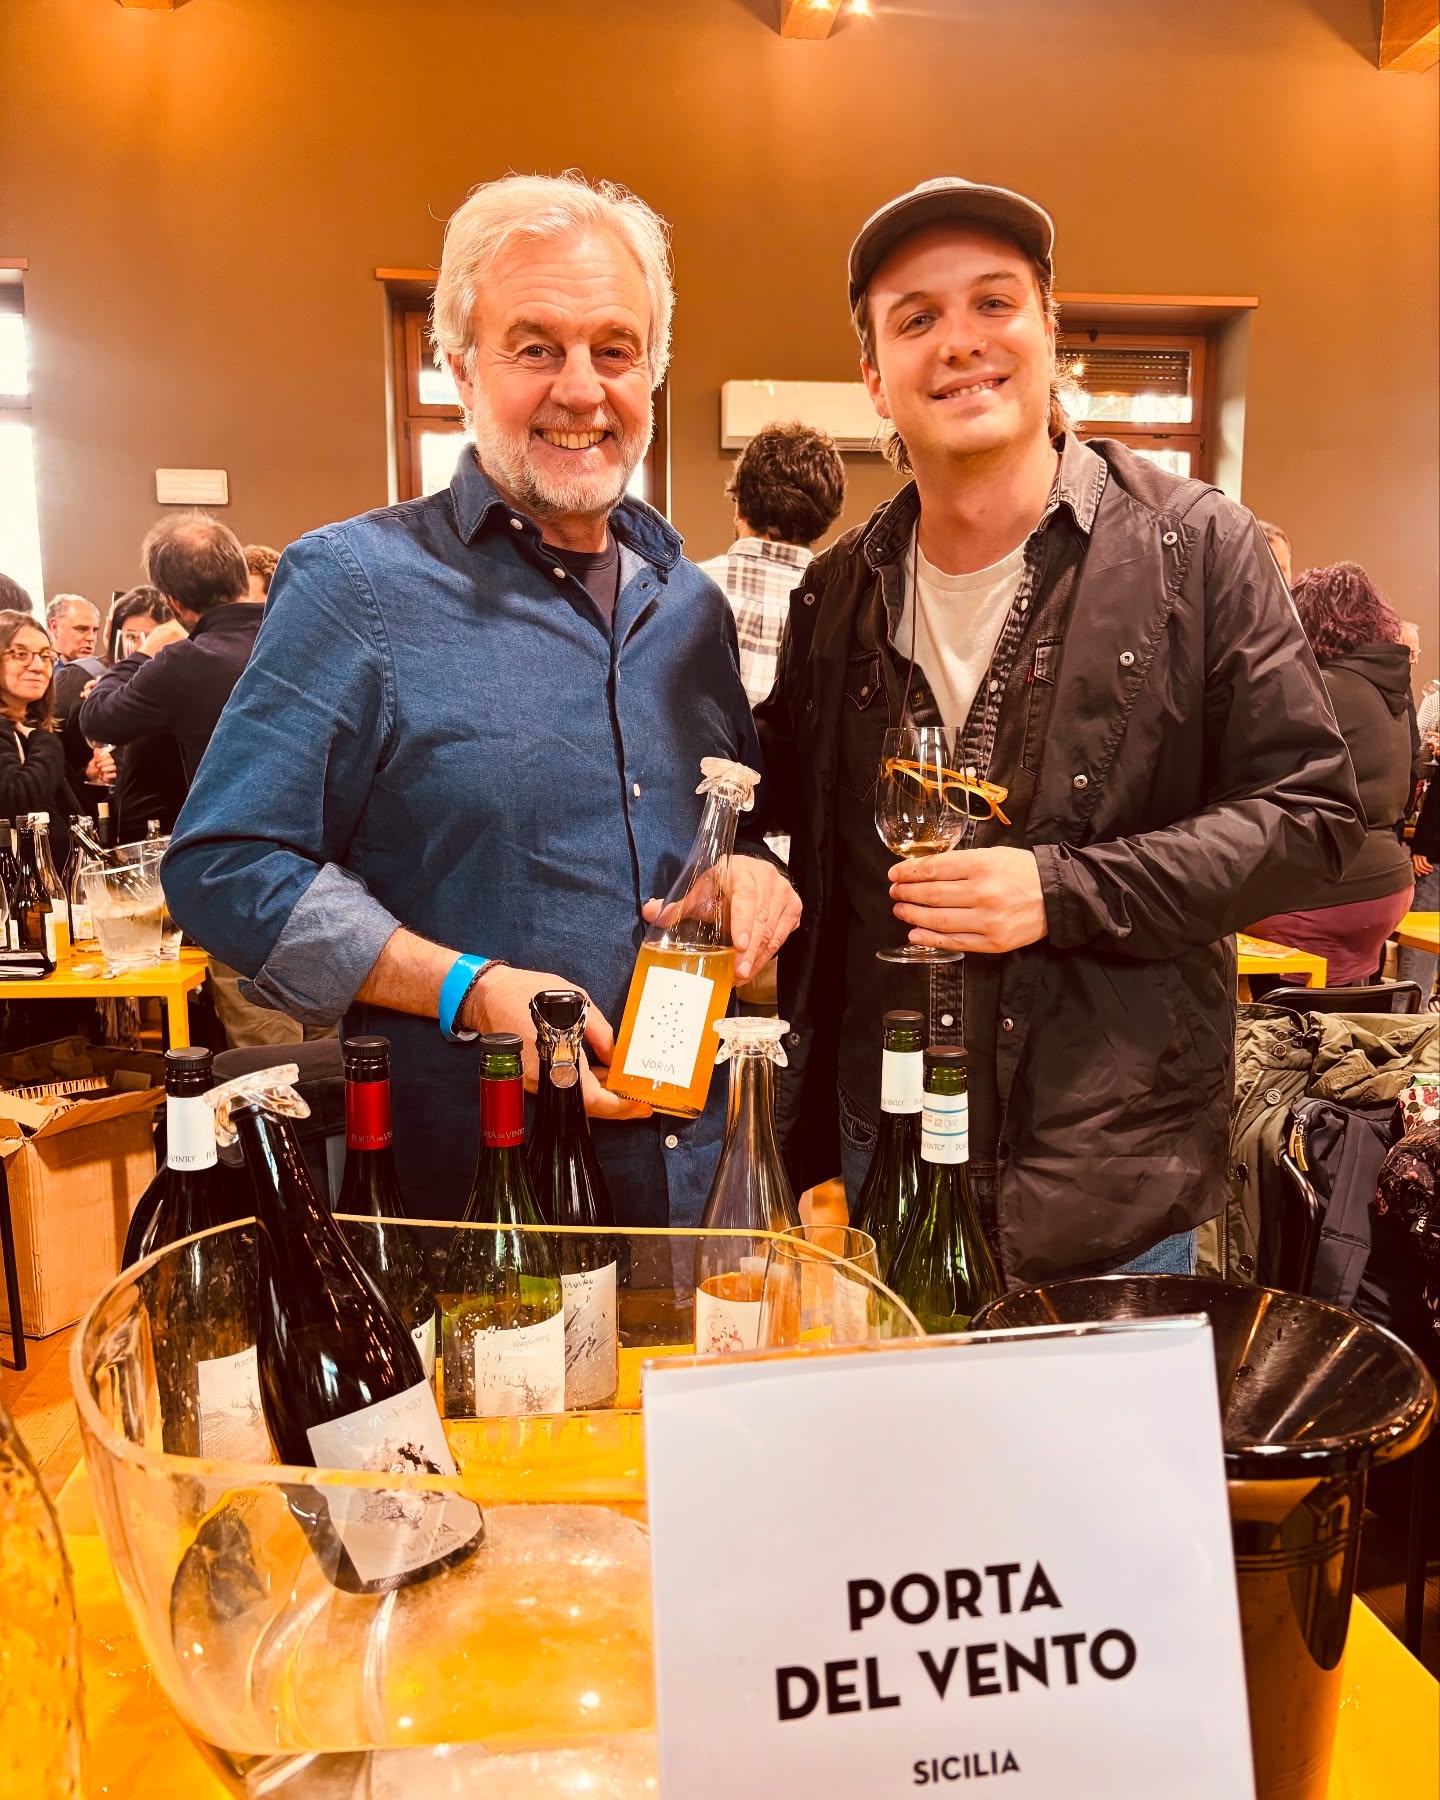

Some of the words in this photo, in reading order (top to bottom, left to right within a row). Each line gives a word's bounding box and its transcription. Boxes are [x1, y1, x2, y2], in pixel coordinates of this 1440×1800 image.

[641, 1057, 675, 1075] VORIA
[846, 1560, 1063, 1632] PORTA
[775, 1655, 902, 1722] DEL
[917, 1628, 1137, 1701] VENTO
[913, 1750, 1020, 1785] SICILIA
